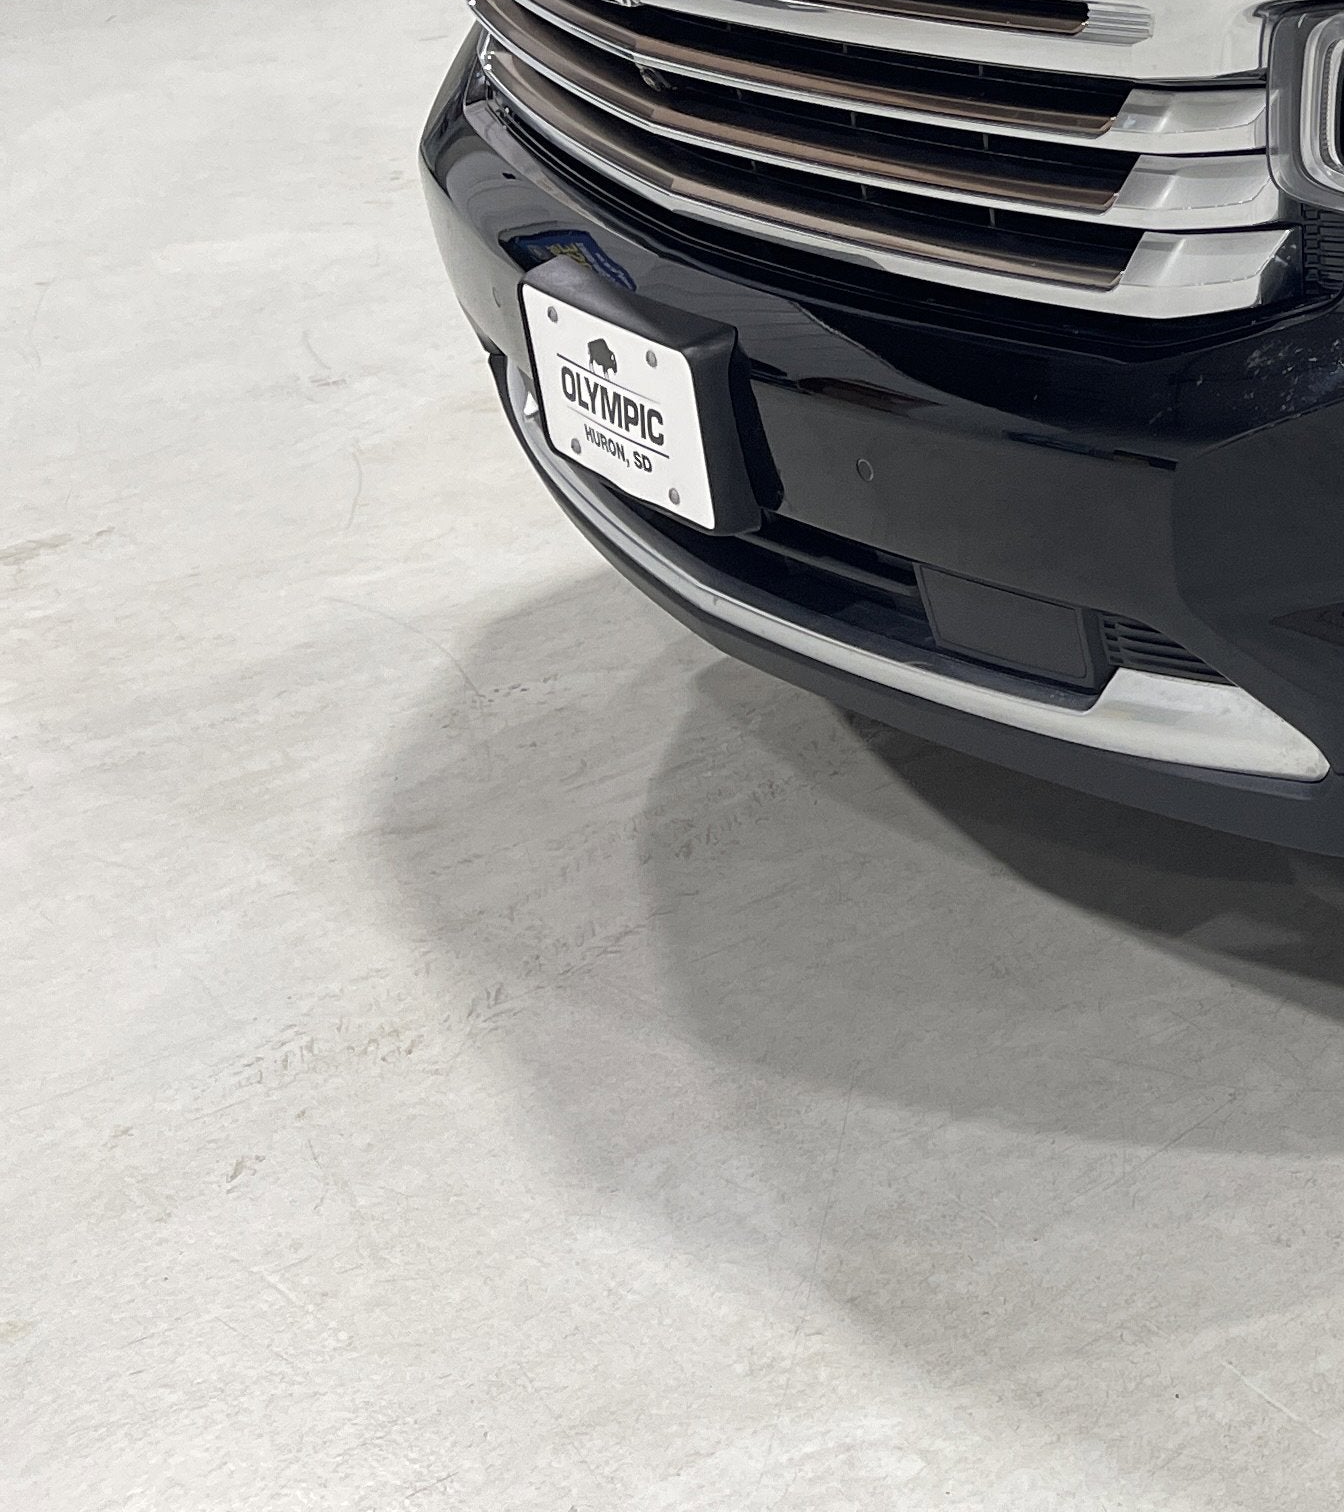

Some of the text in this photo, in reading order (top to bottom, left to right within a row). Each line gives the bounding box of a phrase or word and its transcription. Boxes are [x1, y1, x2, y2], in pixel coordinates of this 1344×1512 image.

[560, 365, 665, 447] OLYMPIC
[583, 422, 653, 473] HURON, SD
